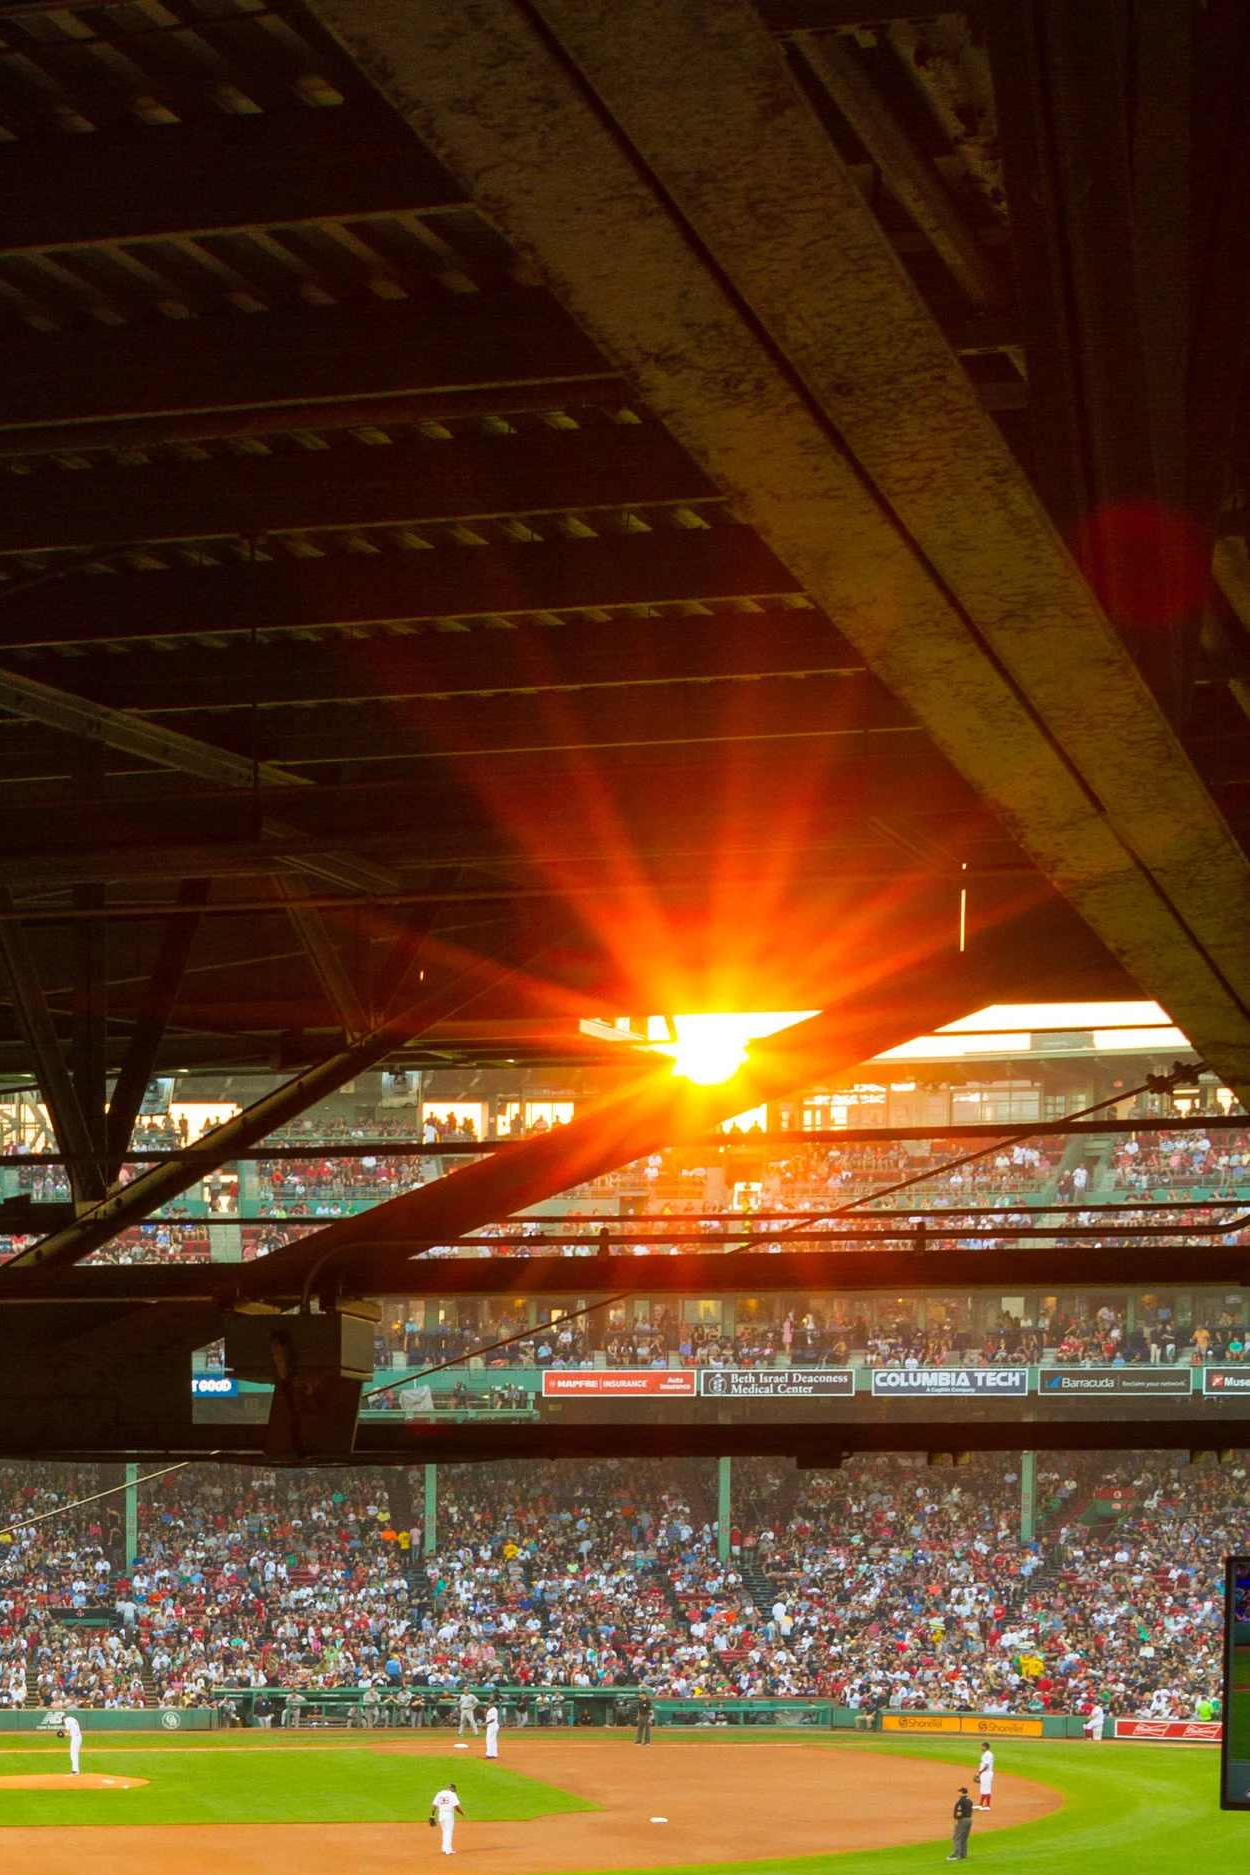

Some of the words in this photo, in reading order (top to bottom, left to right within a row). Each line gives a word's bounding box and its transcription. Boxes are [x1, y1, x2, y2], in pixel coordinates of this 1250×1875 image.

[667, 1376, 684, 1384] Auto
[731, 1373, 757, 1383] Beth
[759, 1373, 790, 1383] Israel
[793, 1373, 848, 1383] Deaconess
[875, 1372, 971, 1387] COLUMBIA
[974, 1373, 1020, 1387] TECH
[1061, 1377, 1115, 1388] Barracuda
[557, 1379, 599, 1388] MAPFRE
[602, 1379, 648, 1388] INSURANCE
[659, 1382, 691, 1390] Insurance
[731, 1383, 780, 1393] Medical
[783, 1383, 814, 1394] Center
[908, 1718, 943, 1728] ShareTel
[988, 1722, 1024, 1733] ShareTel
